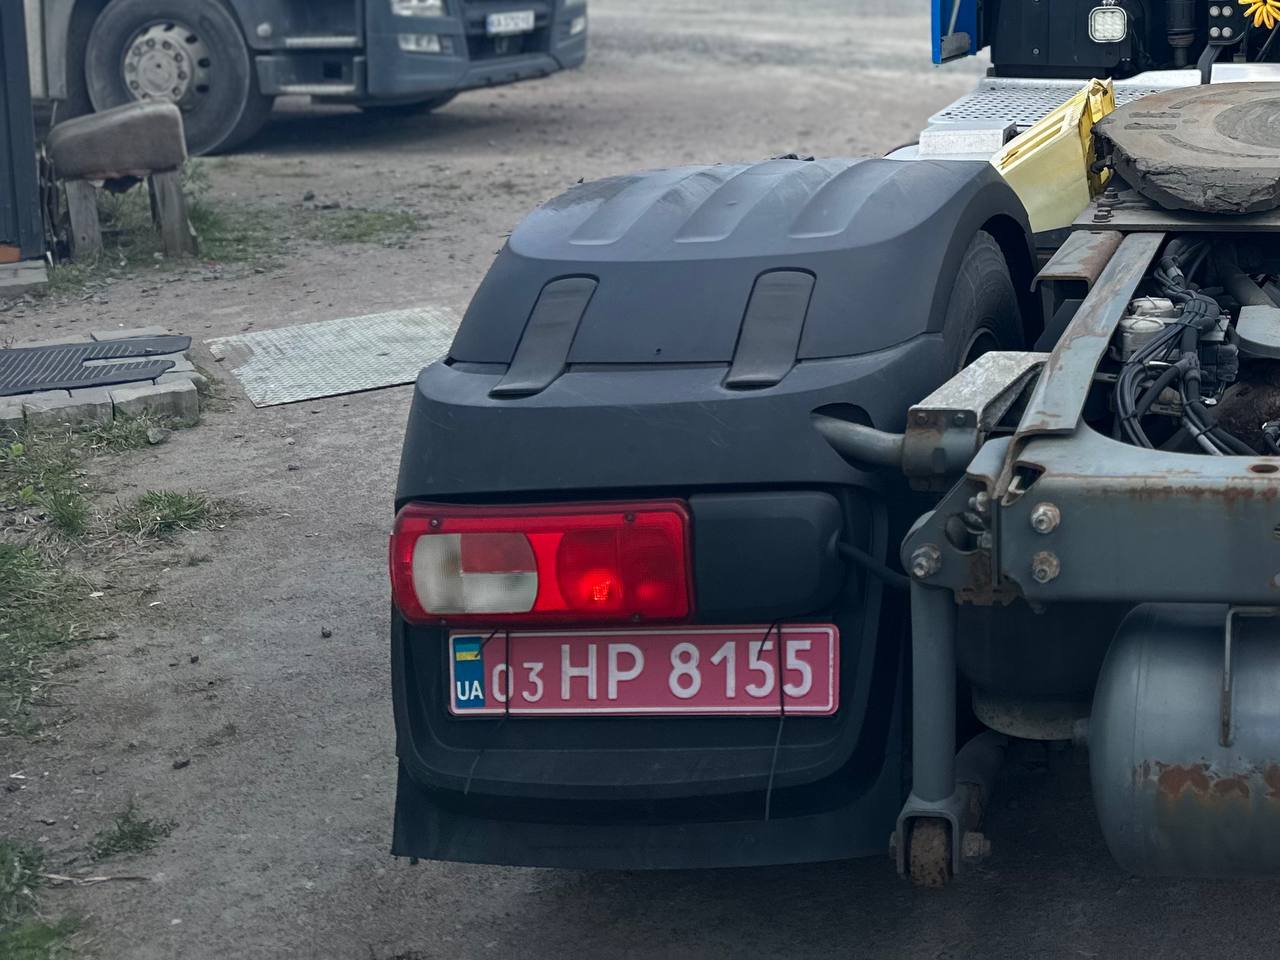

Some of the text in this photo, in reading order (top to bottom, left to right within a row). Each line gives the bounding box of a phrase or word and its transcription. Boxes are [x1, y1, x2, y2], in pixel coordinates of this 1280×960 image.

[456, 640, 813, 703] UA 03 HP 8155
